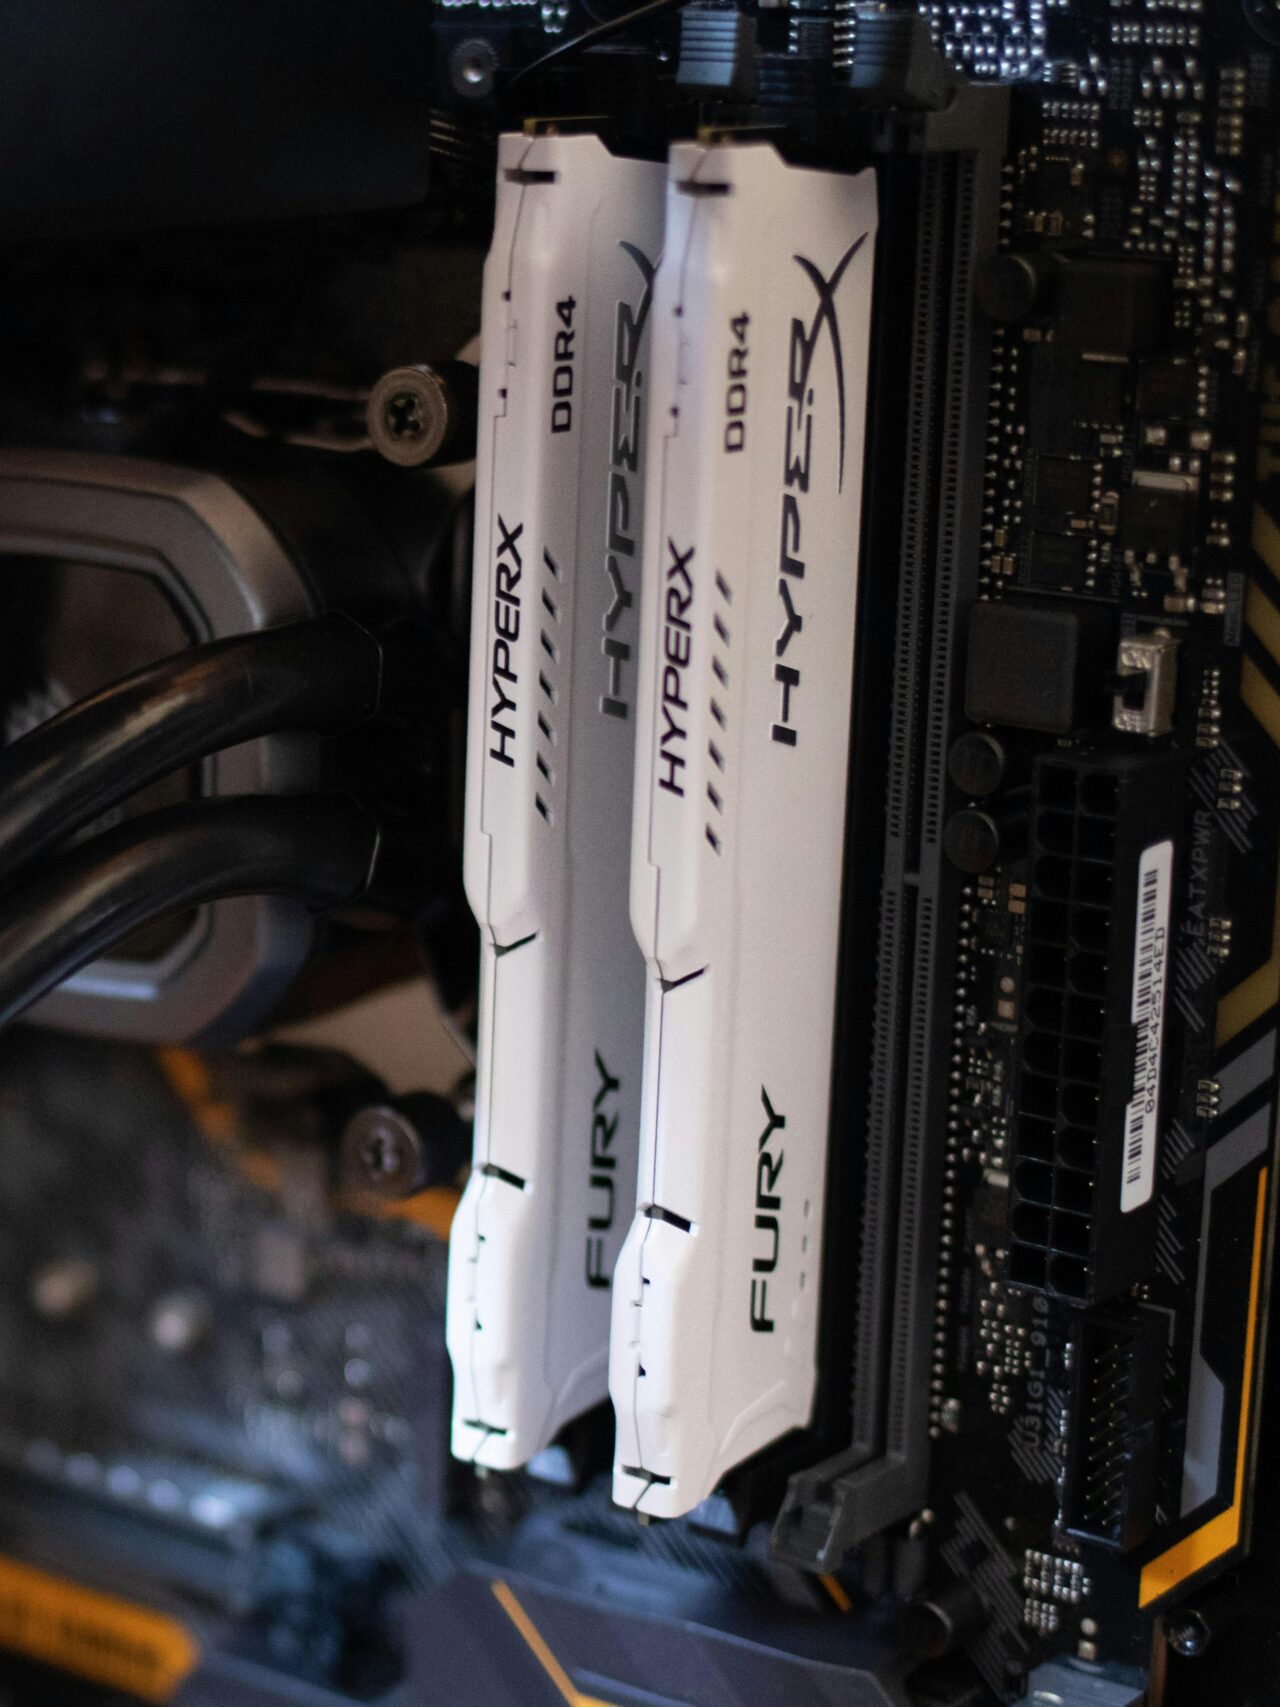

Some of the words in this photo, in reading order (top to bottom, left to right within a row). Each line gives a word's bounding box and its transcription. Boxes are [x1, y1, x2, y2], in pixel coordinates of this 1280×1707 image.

[551, 295, 577, 433] DDR4
[725, 311, 751, 454] DDR4
[771, 231, 869, 748] HYPERX
[489, 513, 524, 768] HYPERX
[658, 535, 695, 798] HYPERX
[1185, 808, 1212, 937] EATXPWR
[1145, 926, 1166, 1115] 04D4C42514ED
[586, 1048, 620, 1290] FURY
[749, 1083, 786, 1333] FURY
